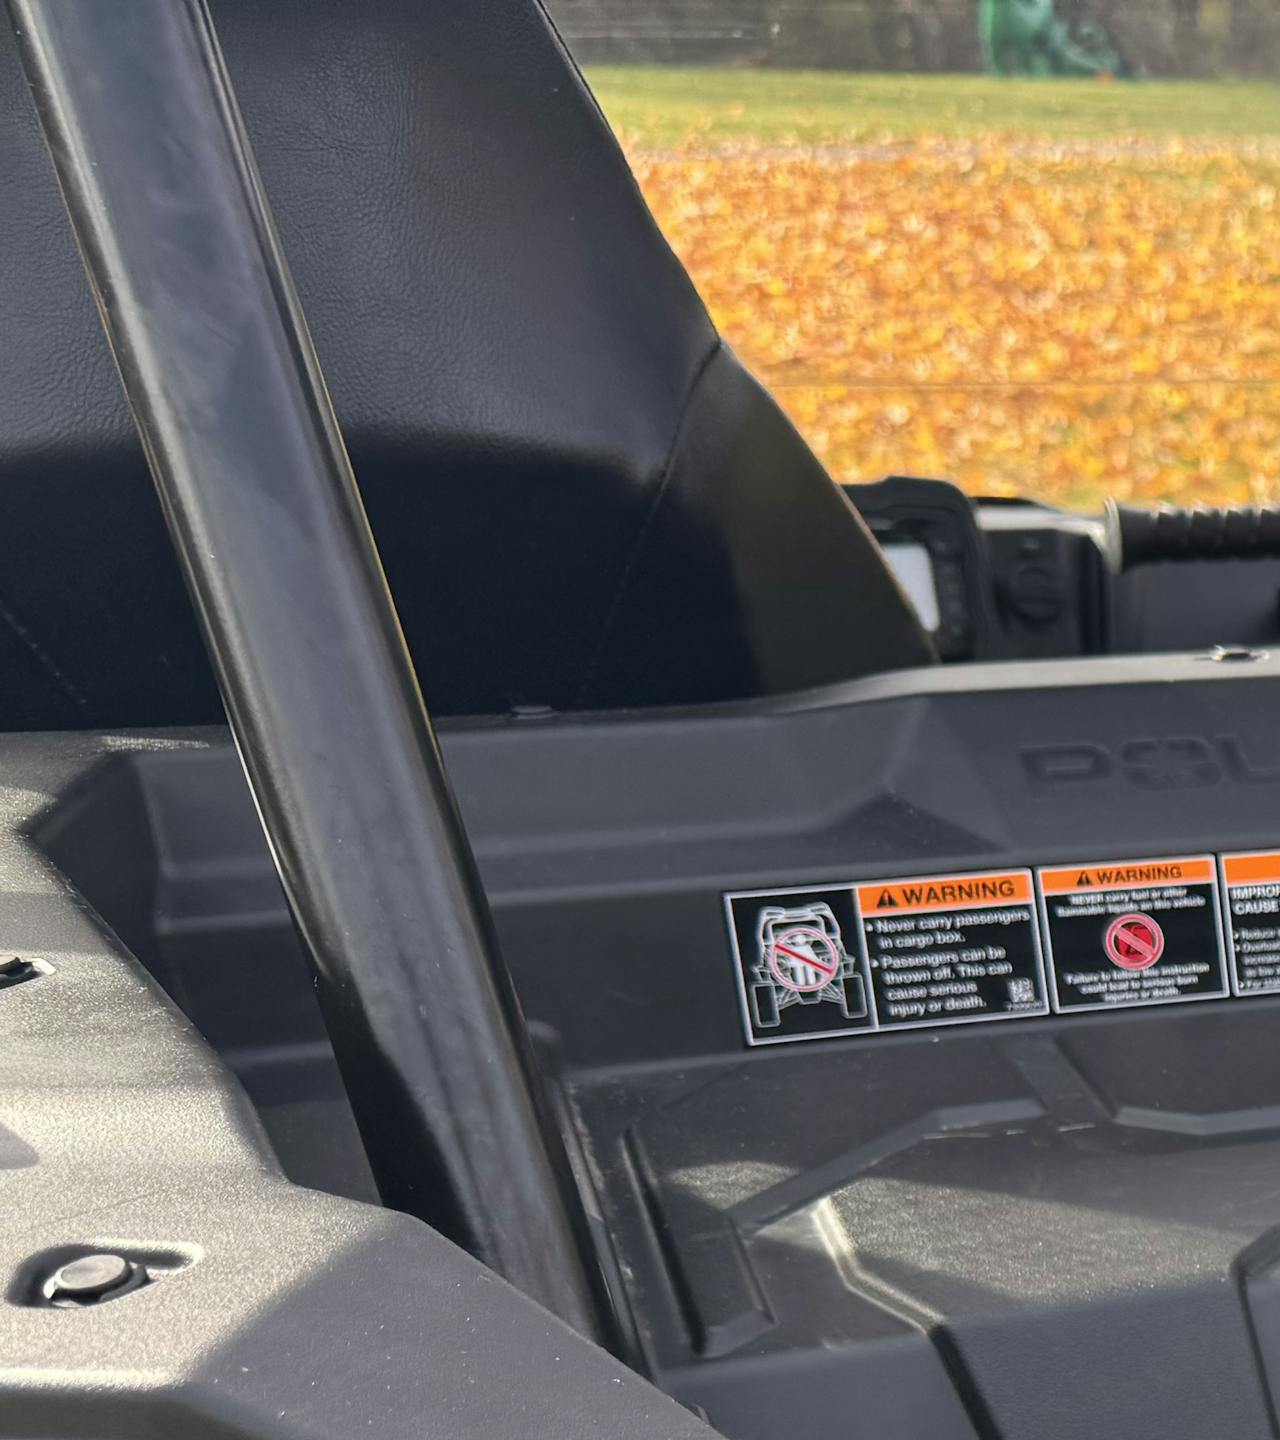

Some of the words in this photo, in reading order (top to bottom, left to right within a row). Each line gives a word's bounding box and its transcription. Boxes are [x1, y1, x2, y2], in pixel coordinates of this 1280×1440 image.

[1097, 866, 1182, 885] WARNING
[902, 880, 1016, 905] WARNING
[1232, 901, 1279, 915] CAUSE
[875, 918, 916, 933] Never
[919, 915, 952, 931] carry
[955, 909, 1030, 929] passengers
[879, 936, 893, 949] in
[894, 934, 934, 950] cargo
[935, 930, 966, 945] box.
[881, 951, 960, 970] Passengers
[961, 948, 987, 962] can
[988, 945, 1006, 960] be
[883, 970, 931, 985] thrown
[933, 967, 955, 981] off.
[957, 963, 986, 978] This
[987, 961, 1013, 976] can
[885, 986, 928, 1001] cause
[929, 980, 978, 996] serious
[888, 1002, 926, 1018] injury
[928, 1000, 943, 1012] or
[944, 995, 987, 1011] death.
